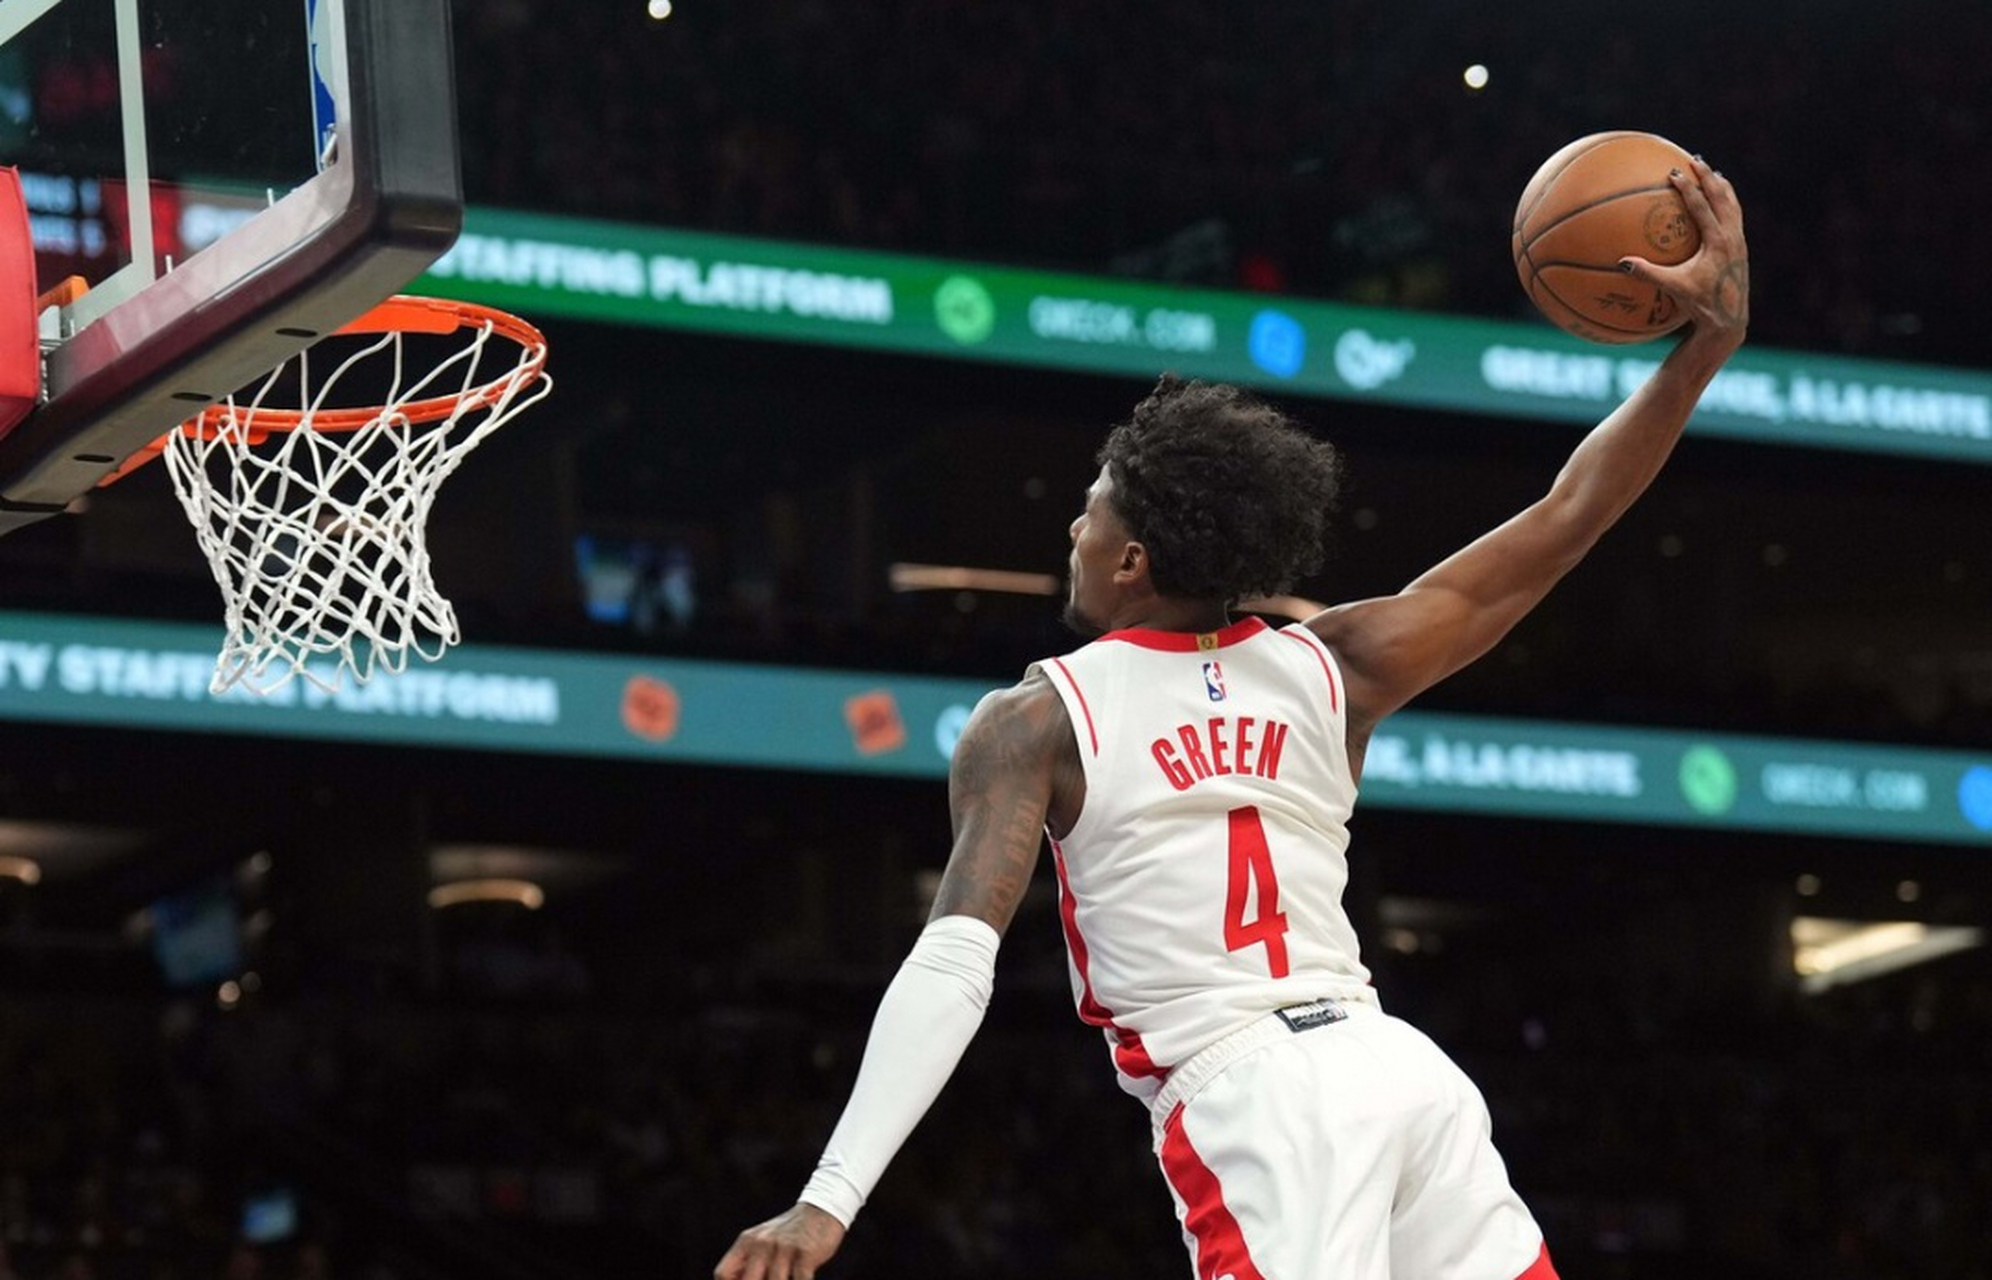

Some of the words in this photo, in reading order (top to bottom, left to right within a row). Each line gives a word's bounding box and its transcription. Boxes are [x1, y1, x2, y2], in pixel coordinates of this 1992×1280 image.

[649, 256, 893, 324] PLATFORM
[1480, 344, 1614, 400] GREAT
[300, 660, 561, 726] PLATFORM
[1151, 716, 1288, 791] GREEN
[1224, 805, 1289, 979] 4
